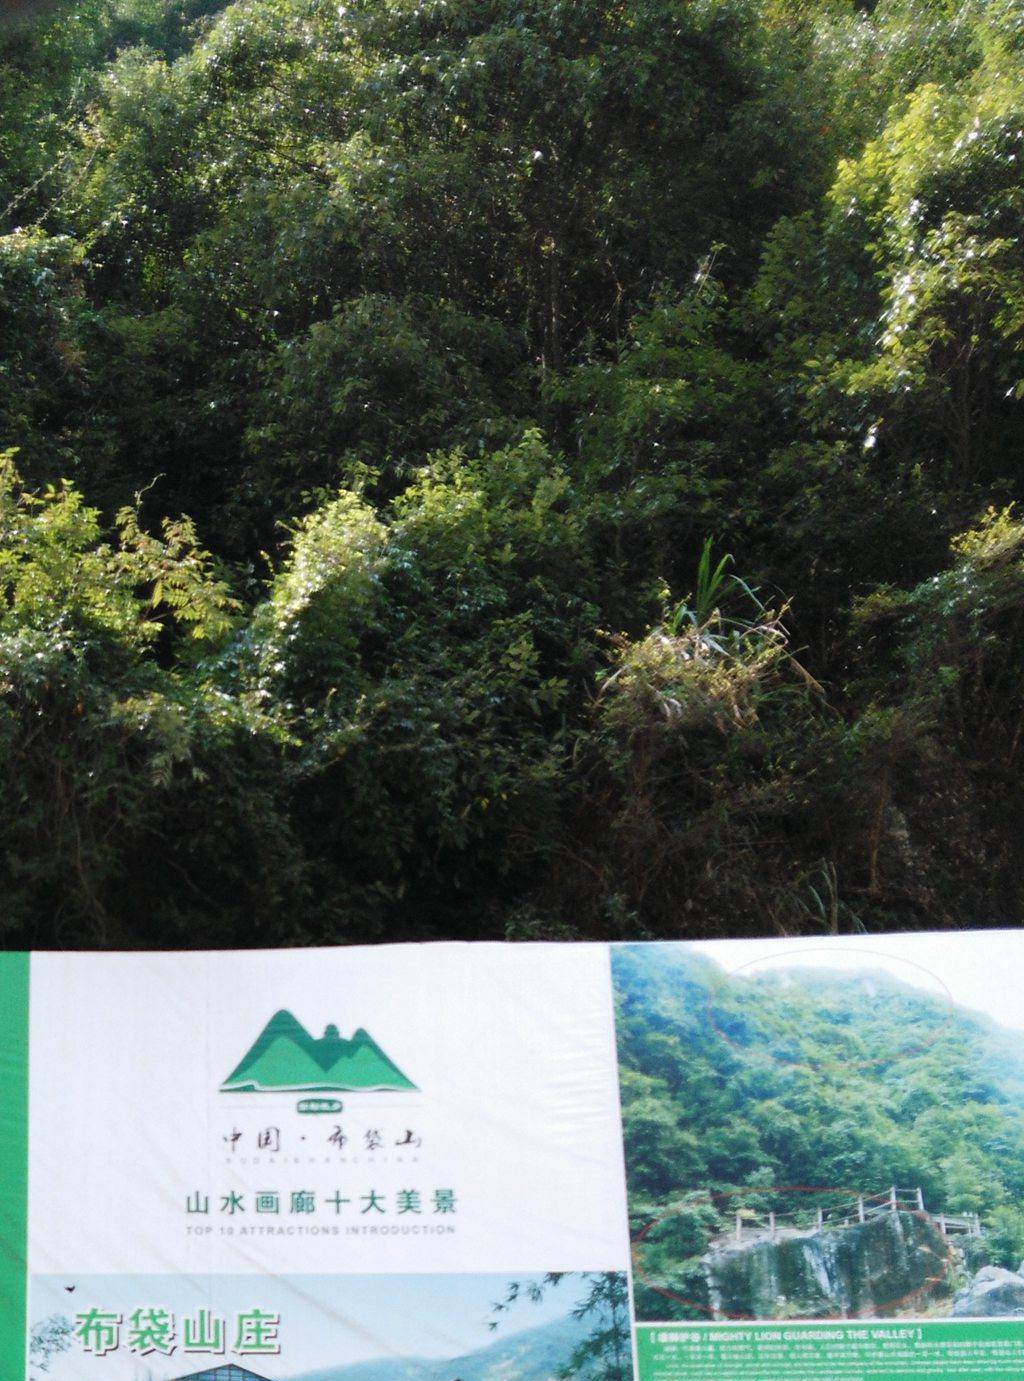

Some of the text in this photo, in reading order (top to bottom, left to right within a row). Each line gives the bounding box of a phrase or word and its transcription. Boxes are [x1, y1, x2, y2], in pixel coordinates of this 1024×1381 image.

[186, 1189, 458, 1215] 山水画廊十大美景
[187, 1225, 455, 1237] TOP 10 ATTRACTIONS INTRODUCTION
[74, 1307, 280, 1354] 布袋山庄
[709, 1331, 752, 1341] MIGHTY
[754, 1331, 782, 1341] LION
[782, 1331, 845, 1341] GUARDING
[846, 1330, 869, 1340] THE
